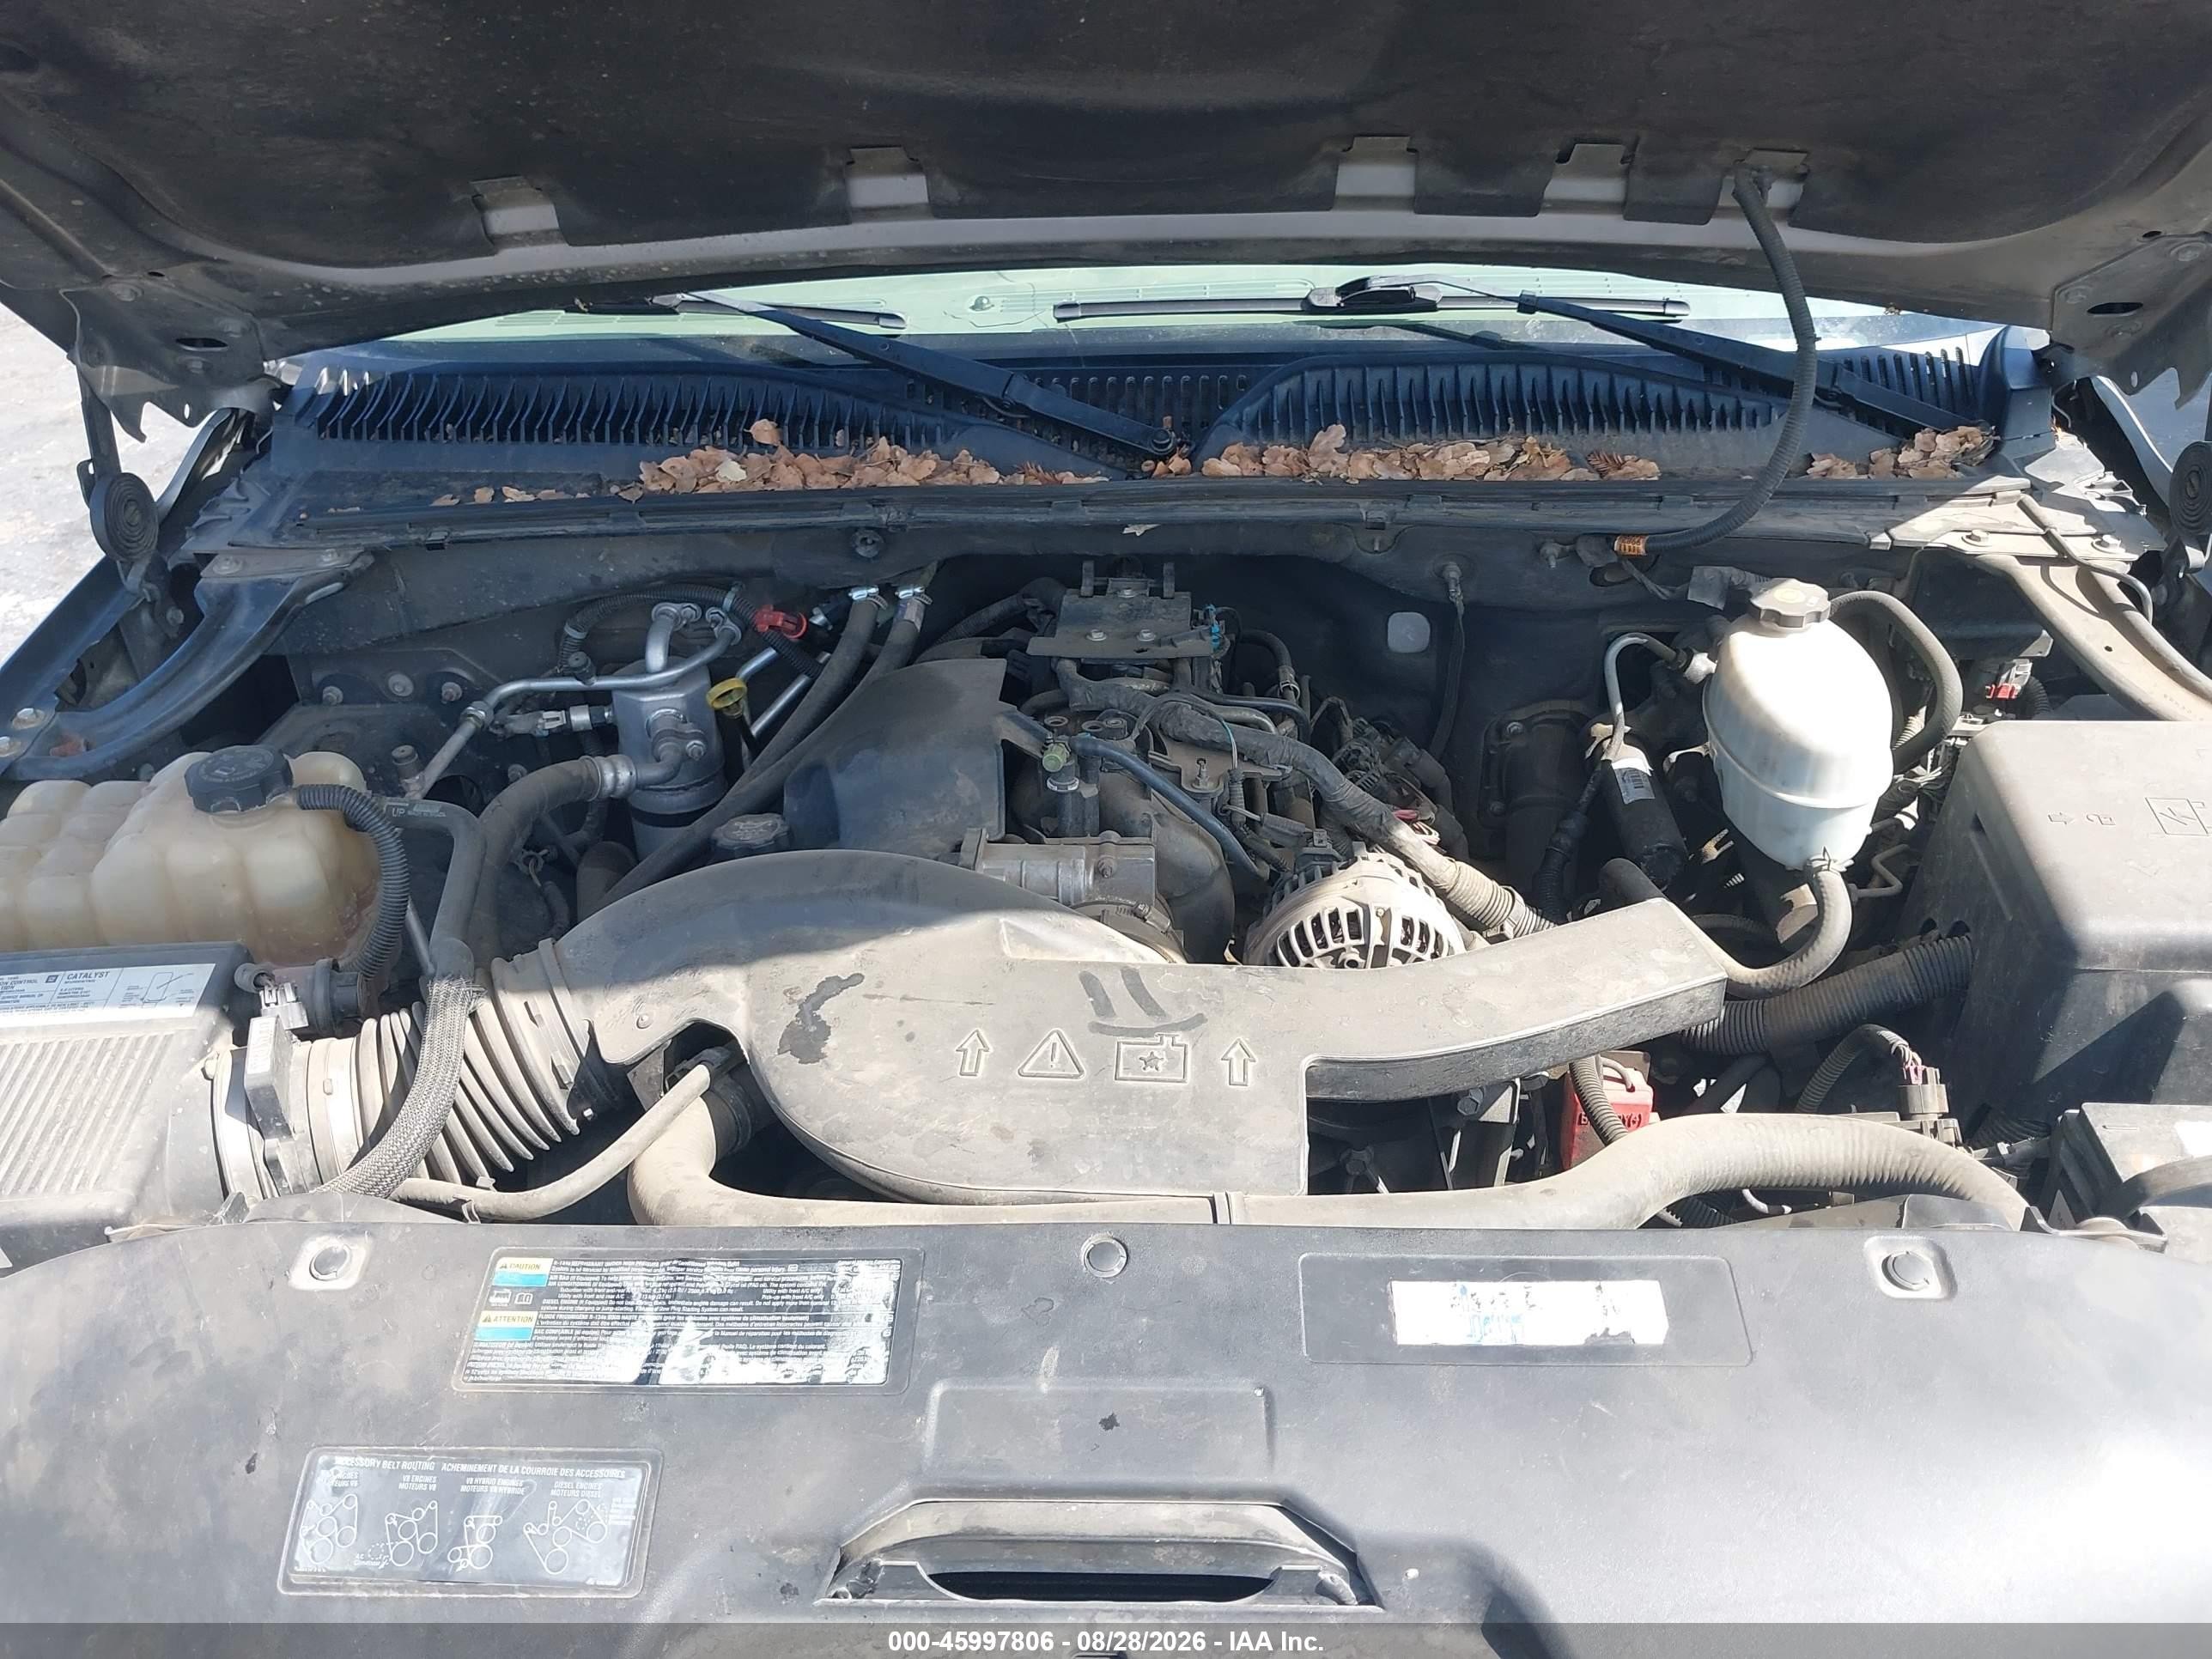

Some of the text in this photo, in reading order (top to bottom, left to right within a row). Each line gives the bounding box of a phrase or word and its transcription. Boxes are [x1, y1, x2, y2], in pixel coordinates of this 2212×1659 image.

[392, 807, 405, 817] UP
[66, 971, 111, 981] CATALYST
[509, 1262, 541, 1271] CAUTION
[493, 1315, 534, 1324] ATTENTION
[382, 1460, 399, 1470] BELT
[401, 1461, 435, 1471] ROUTING
[441, 1462, 497, 1474] ACHEMINEMENT
[499, 1464, 508, 1474] DE
[509, 1464, 520, 1475] LA
[521, 1465, 558, 1476] COURROIE
[560, 1467, 574, 1477] DES
[575, 1468, 626, 1479] ACCESSOIRES
[411, 1474, 437, 1483] ENGINES
[474, 1478, 496, 1486] HYBRID
[497, 1479, 525, 1487] ENGINES
[398, 1482, 437, 1492] MOTEURS V8
[460, 1485, 489, 1493] MOTEURS
[499, 1486, 526, 1496] HYBRIDE
[554, 1480, 603, 1491] DIESEL ENGINES
[550, 1488, 602, 1498] MOTEURS DIESEL
